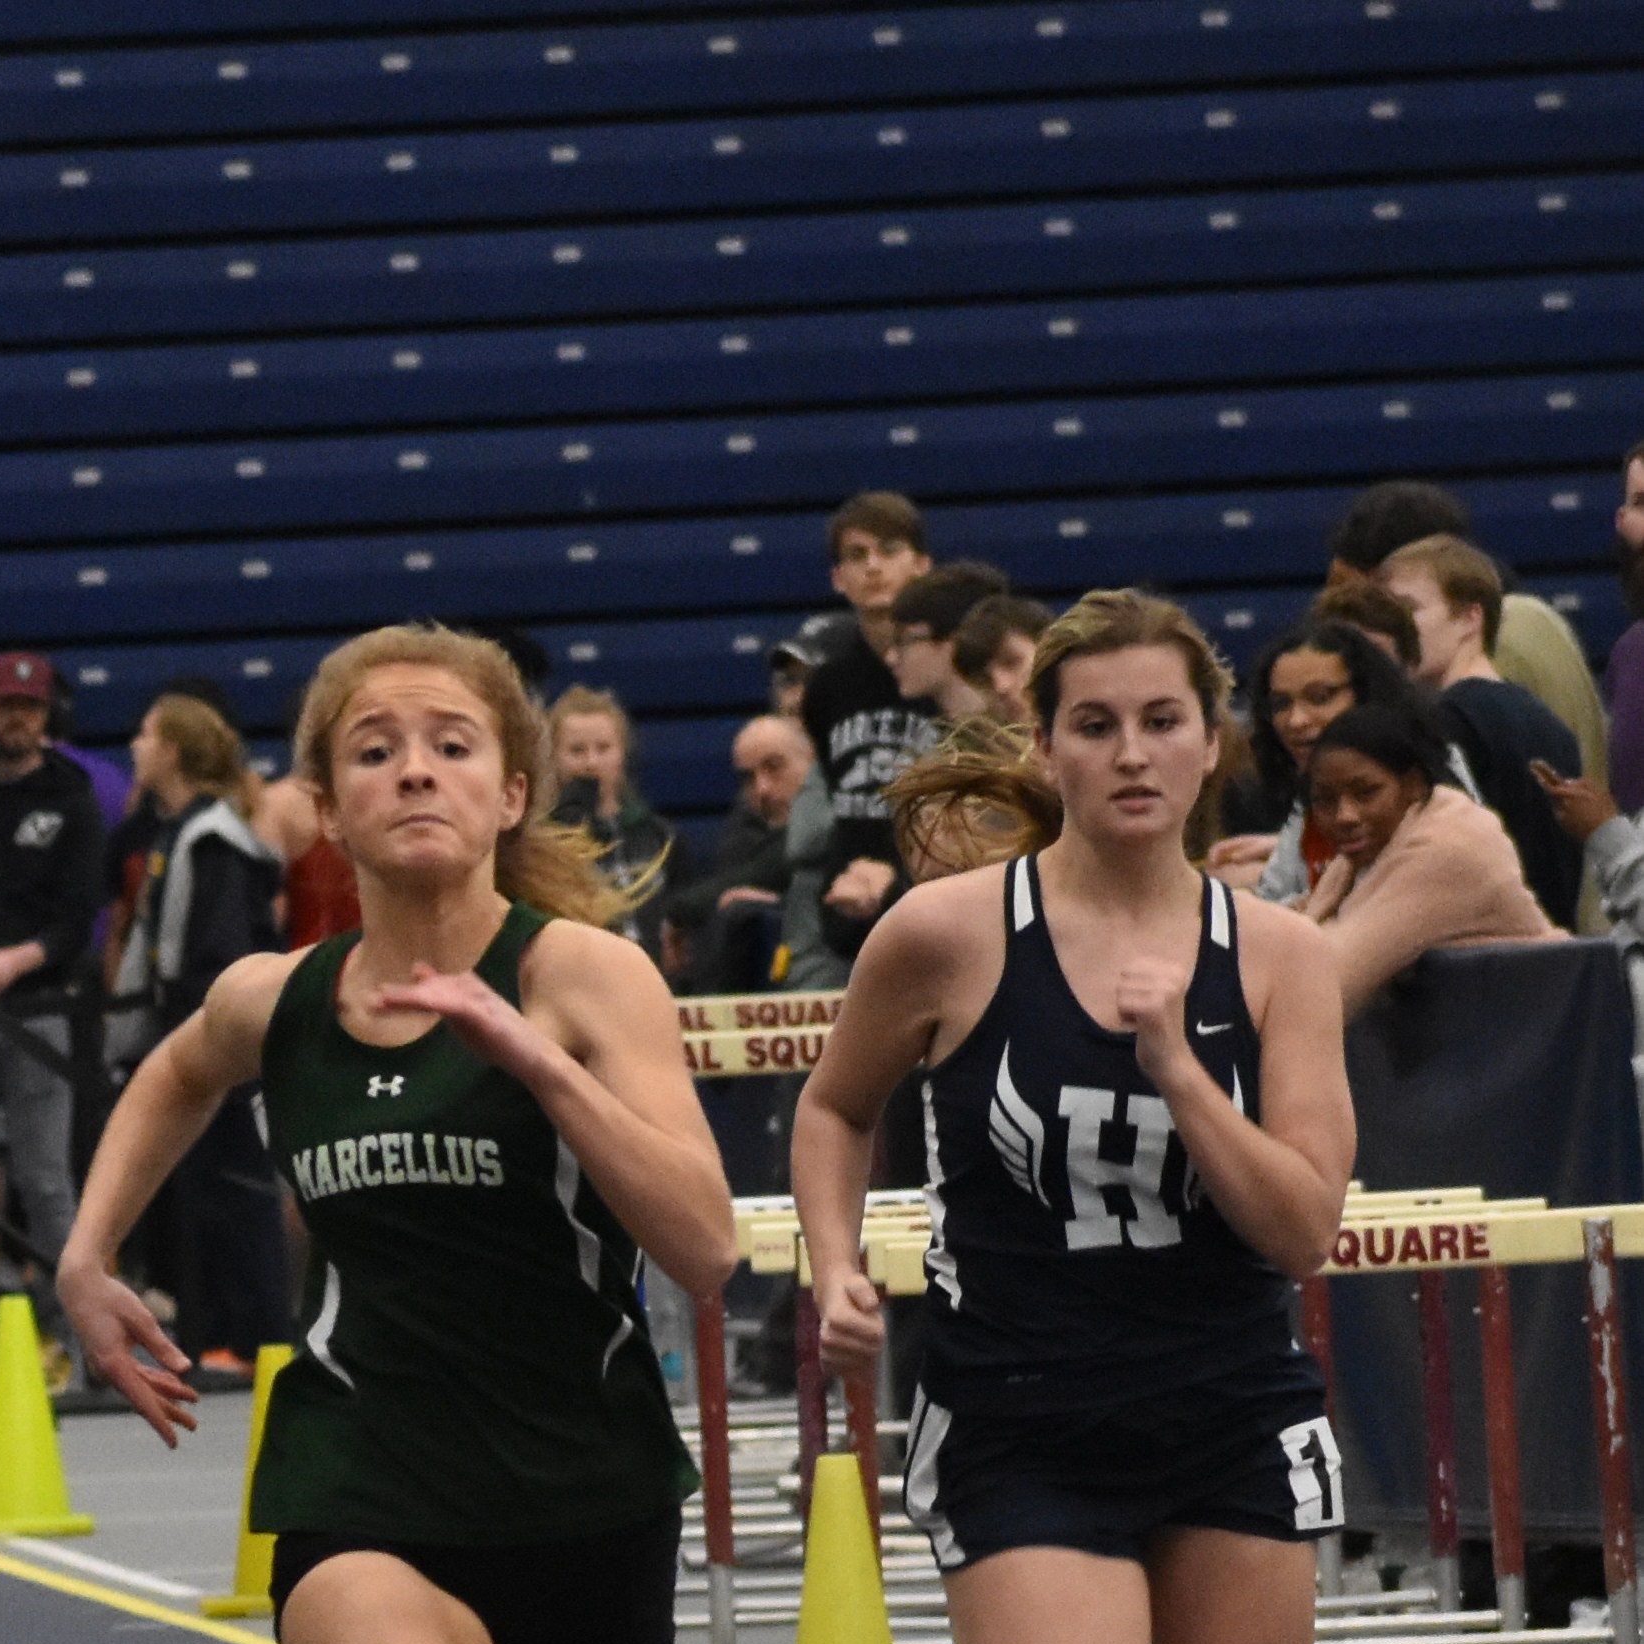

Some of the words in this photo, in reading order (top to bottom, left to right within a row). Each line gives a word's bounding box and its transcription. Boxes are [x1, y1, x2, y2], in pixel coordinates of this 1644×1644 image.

[292, 1132, 505, 1201] MARCELLUS
[1058, 1085, 1183, 1251] H
[1299, 1428, 1334, 1521] 1
